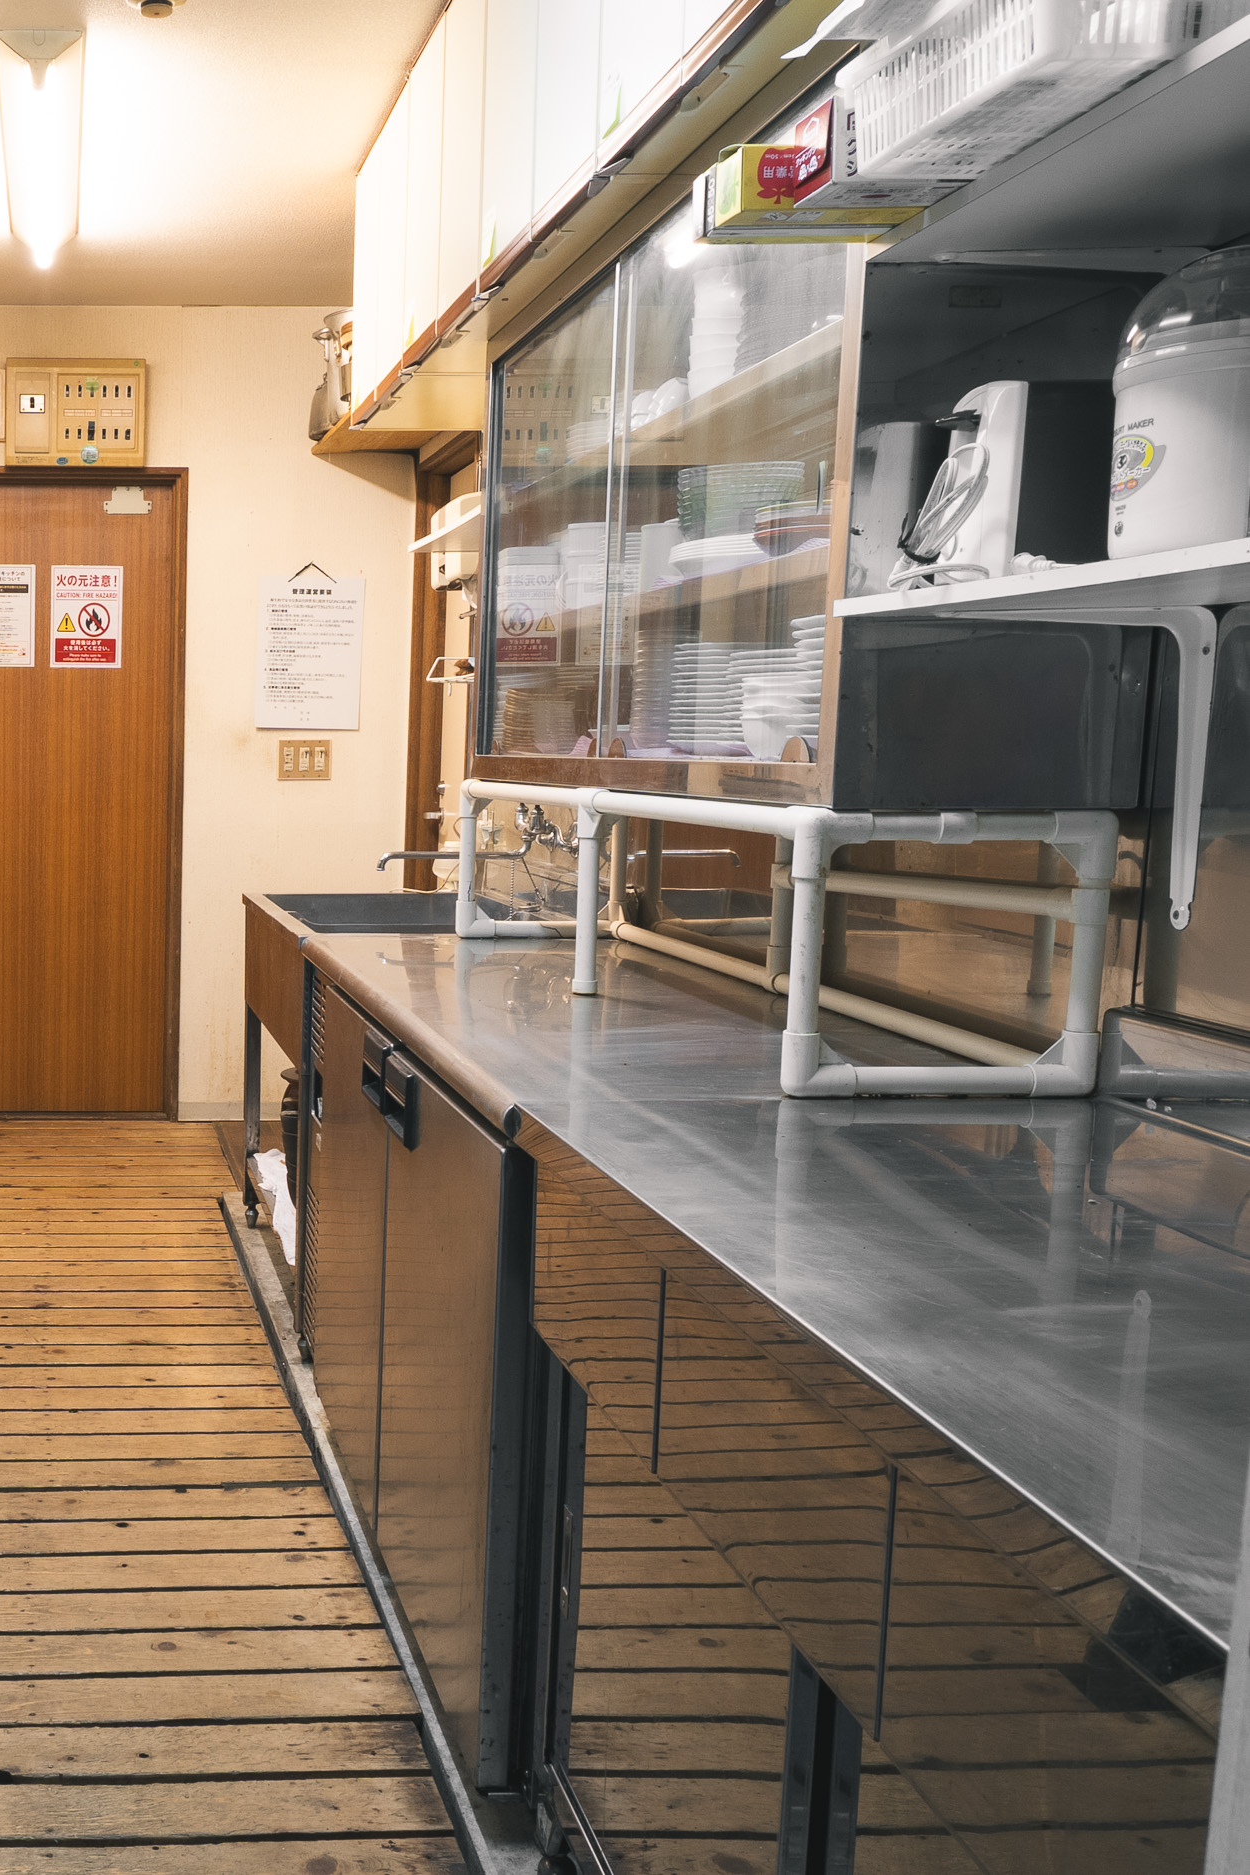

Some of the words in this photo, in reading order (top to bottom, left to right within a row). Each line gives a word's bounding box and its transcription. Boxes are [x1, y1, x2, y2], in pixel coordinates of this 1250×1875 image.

[1128, 418, 1154, 431] MAKER
[56, 574, 117, 587] 火の元注意！
